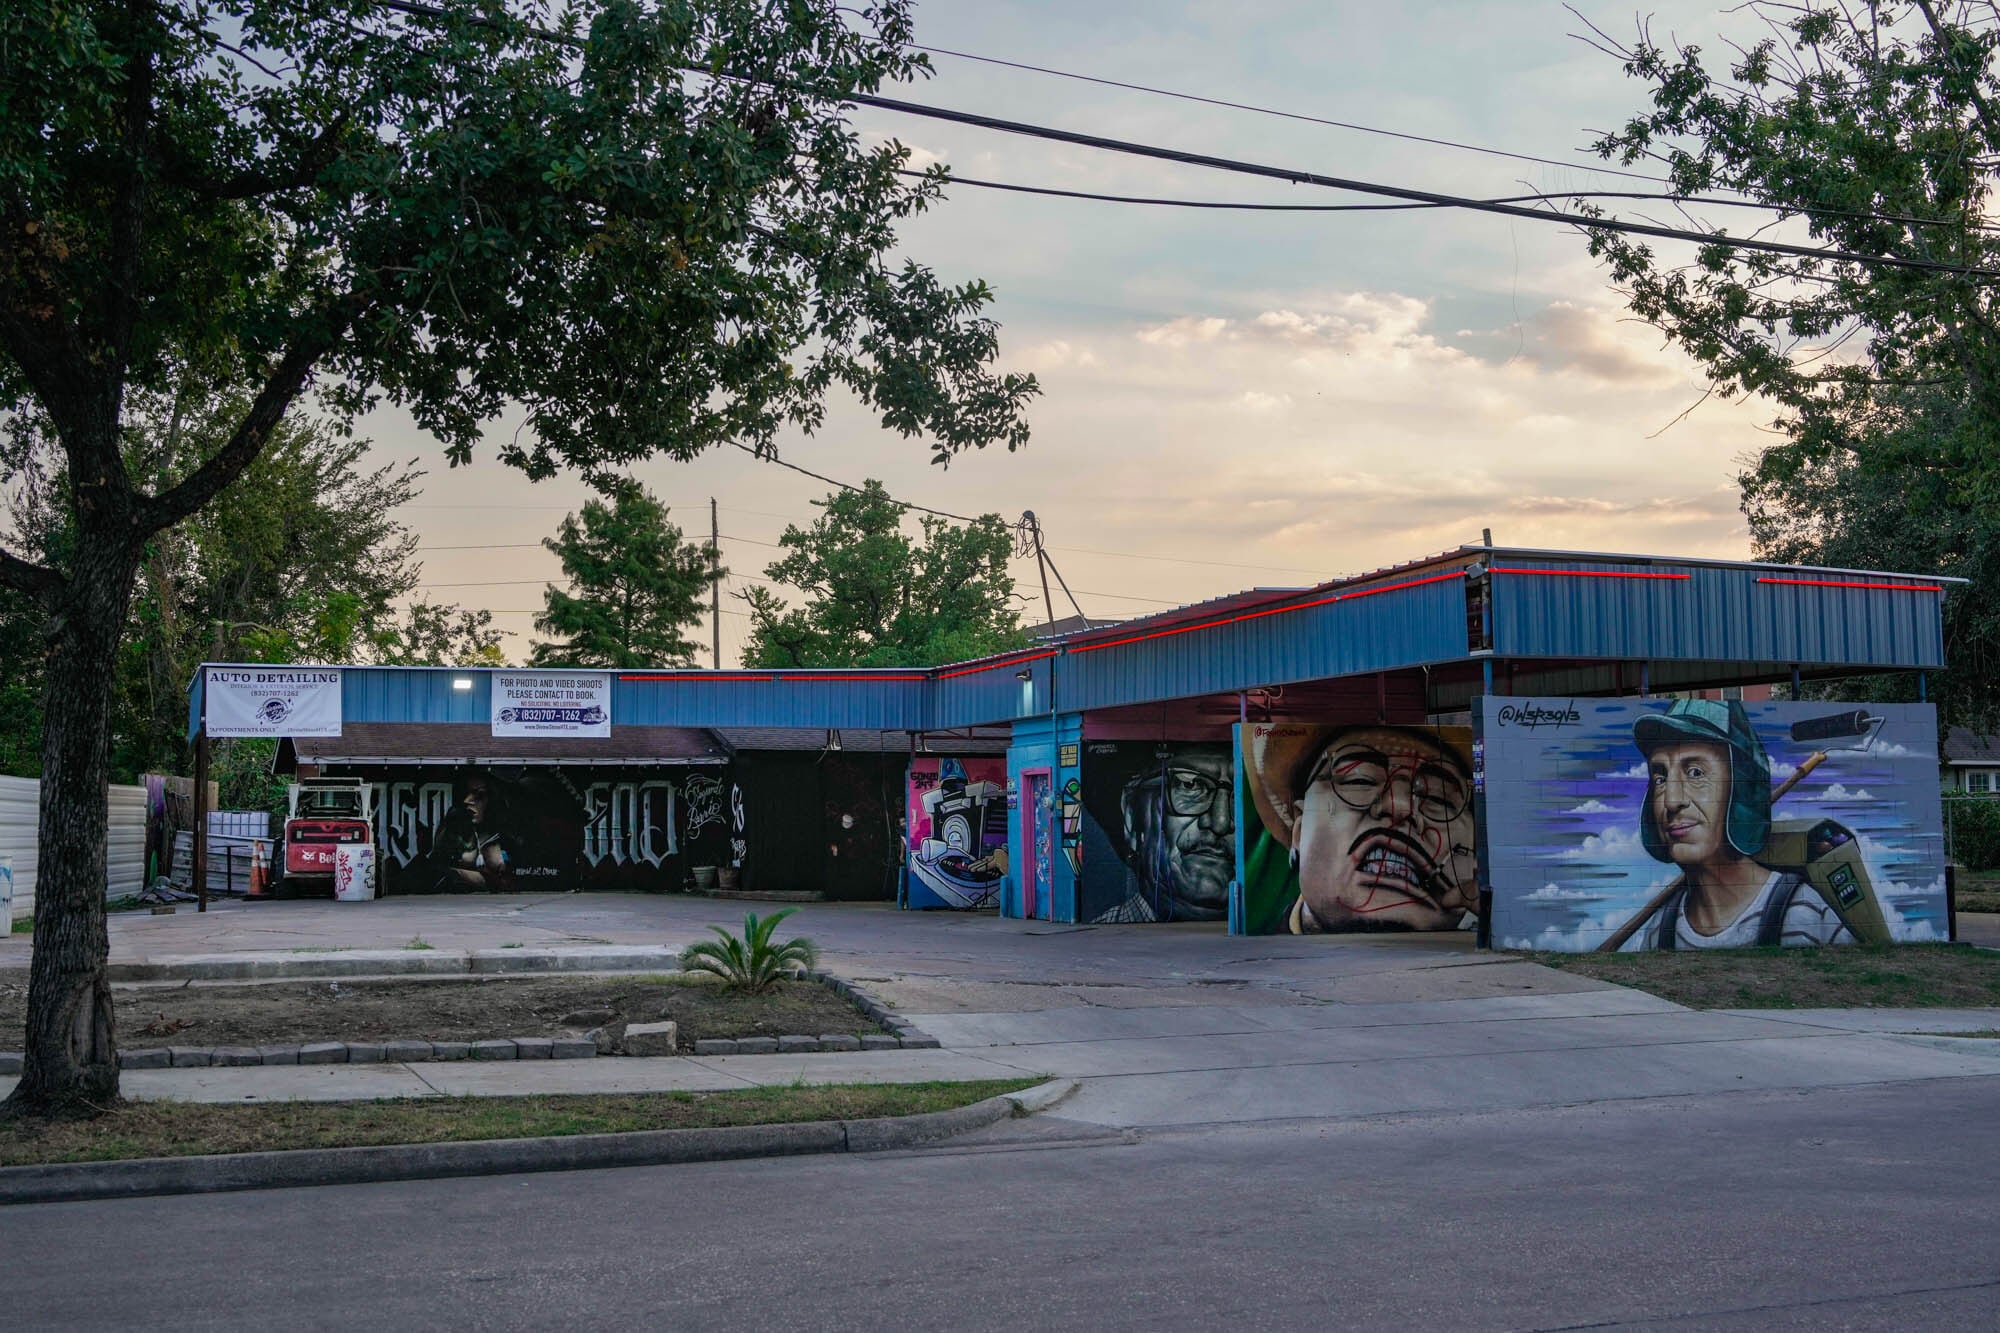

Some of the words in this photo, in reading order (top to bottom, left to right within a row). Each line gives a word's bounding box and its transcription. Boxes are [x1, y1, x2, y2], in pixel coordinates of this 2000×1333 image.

[210, 673, 251, 683] AUTO
[256, 674, 338, 683] DETAILING
[500, 678, 514, 688] FOR
[516, 678, 538, 688] PHOTO
[539, 679, 554, 688] AND
[555, 679, 576, 689] VIDEO
[577, 679, 603, 689] SHOOTS
[507, 690, 533, 699] PLEASE
[534, 690, 564, 699] CONTACT
[566, 690, 574, 700] TO
[575, 690, 596, 700] BOOK.
[521, 709, 580, 721] (832)707-1262
